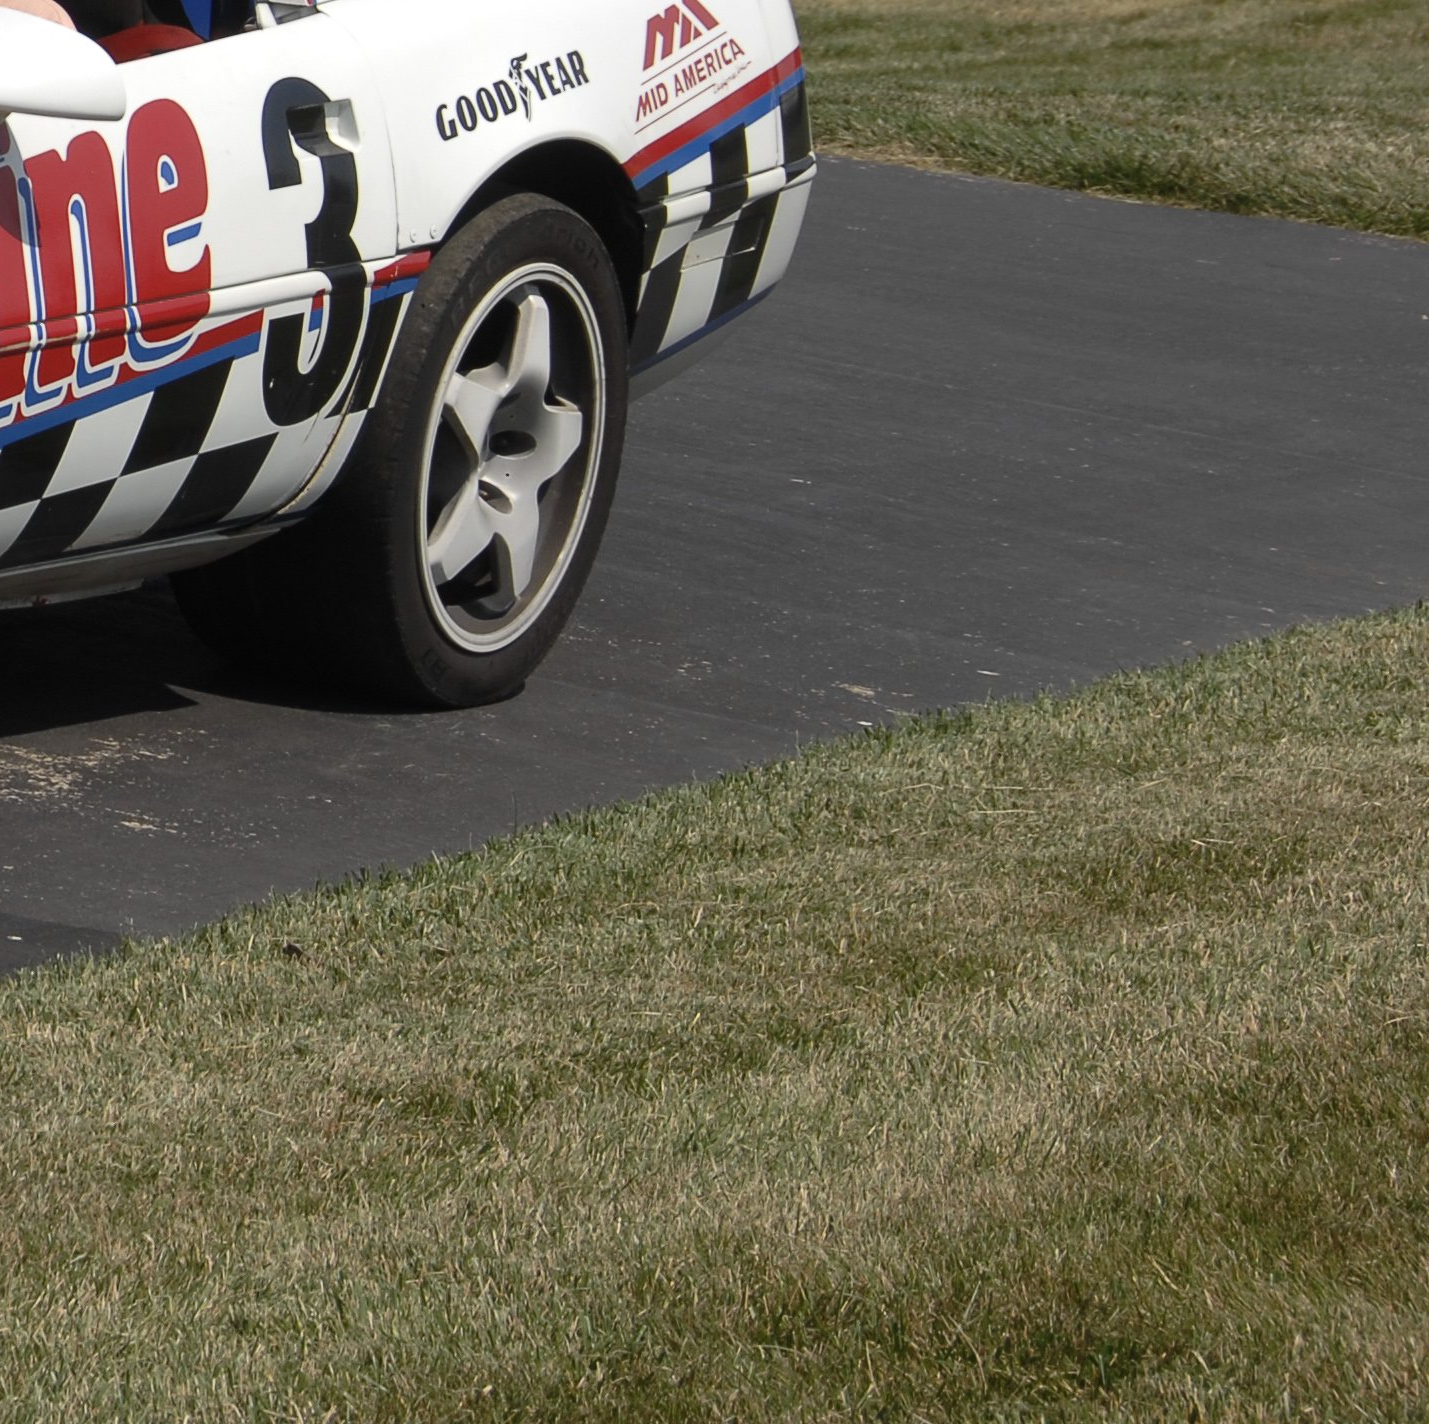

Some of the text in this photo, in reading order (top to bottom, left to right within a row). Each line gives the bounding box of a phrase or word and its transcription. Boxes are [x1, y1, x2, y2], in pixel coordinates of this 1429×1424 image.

[436, 49, 590, 142] GOODYEAR
[636, 82, 669, 122] MID
[673, 38, 745, 98] AMERICA
[261, 75, 362, 428] 3
